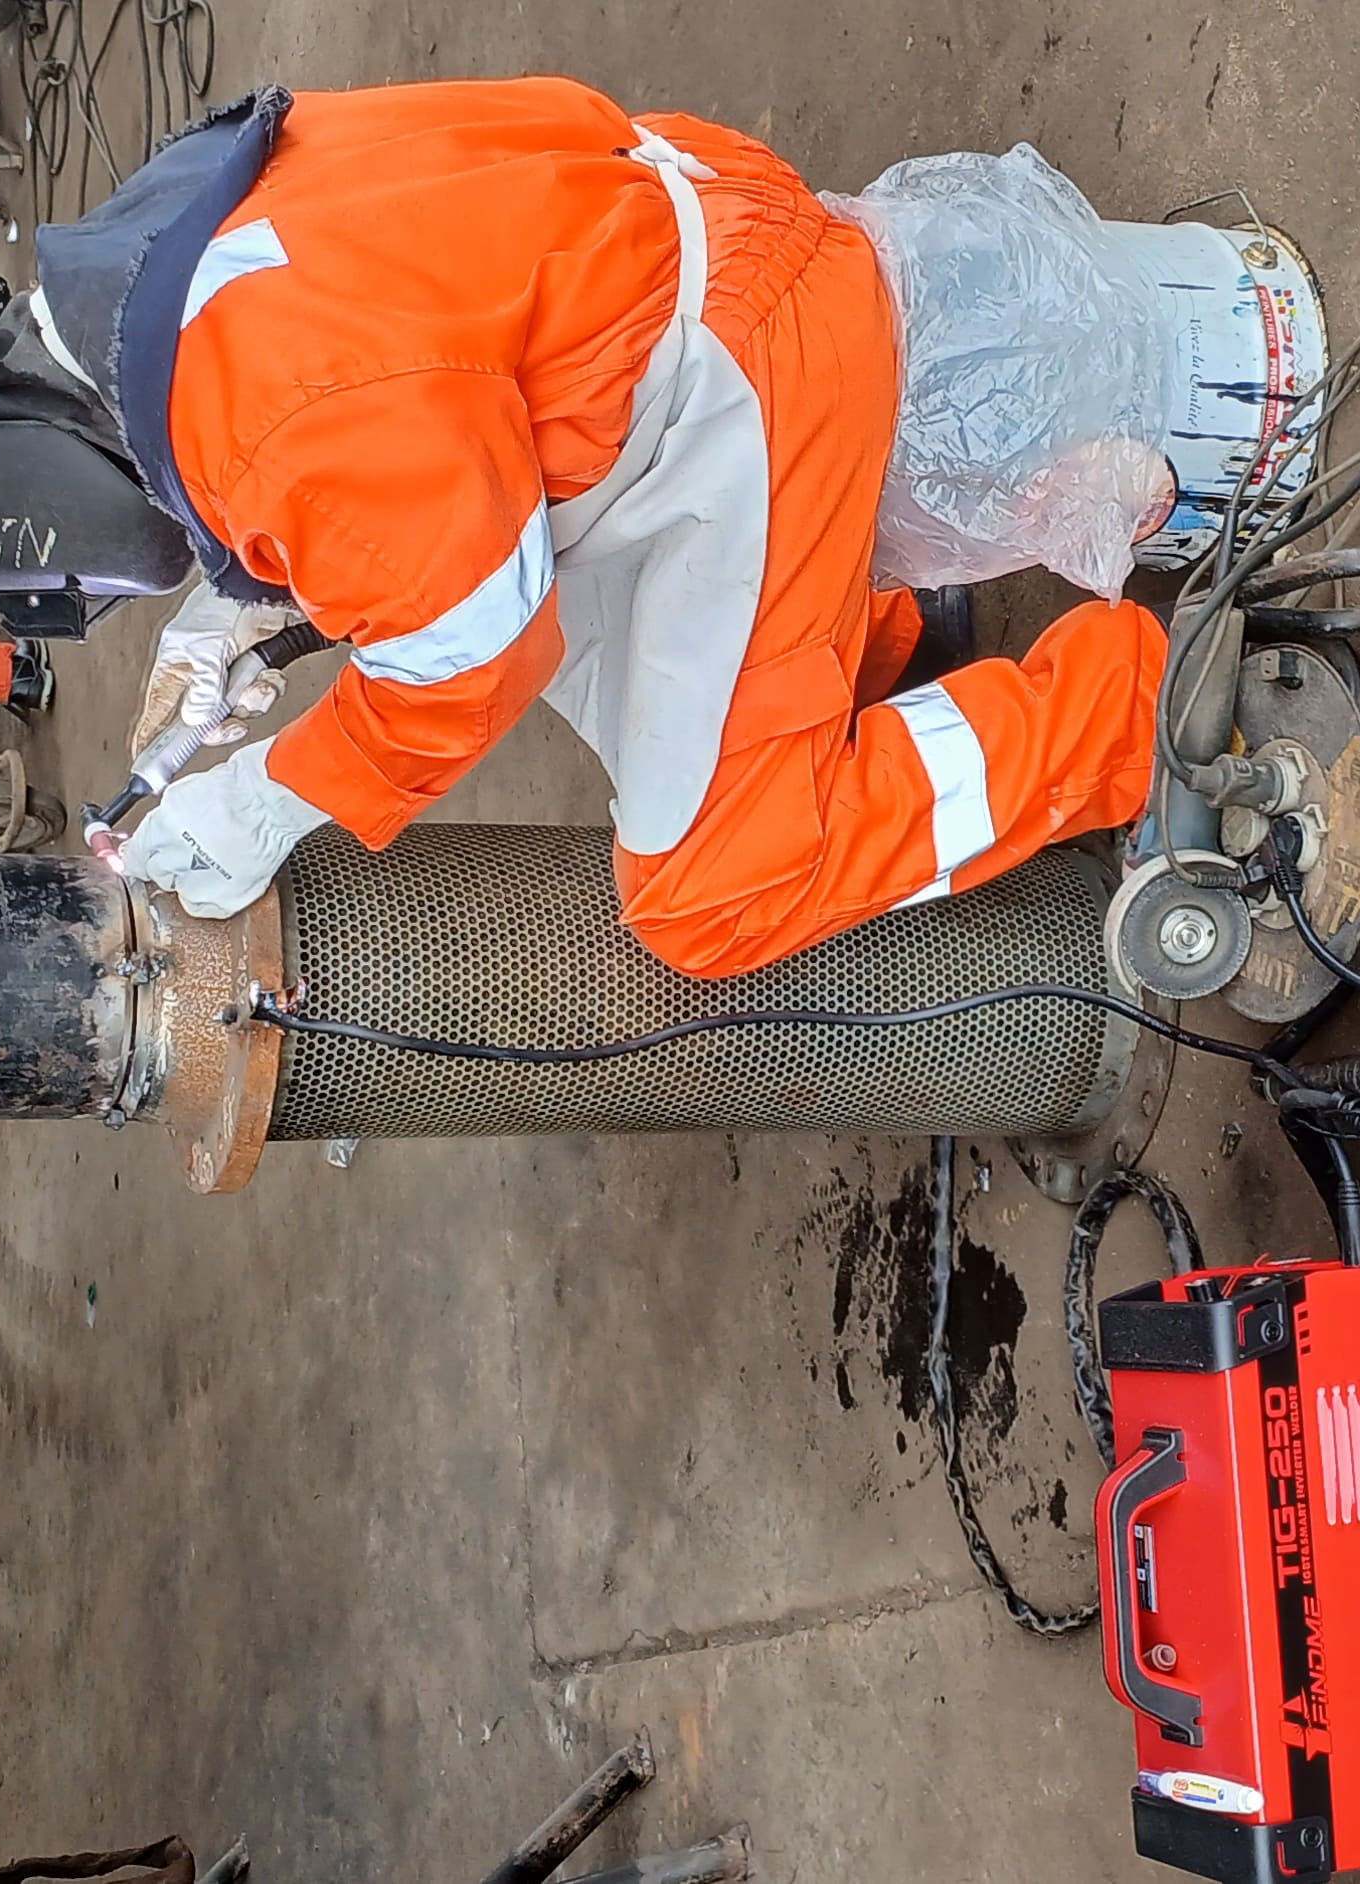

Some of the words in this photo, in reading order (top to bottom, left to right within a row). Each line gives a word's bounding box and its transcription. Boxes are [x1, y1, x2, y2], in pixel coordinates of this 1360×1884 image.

[1258, 288, 1278, 350] PEINTURES
[181, 831, 232, 880] DELTAPLUS
[1288, 1385, 1301, 1435] WELDER
[1264, 1386, 1300, 1589] TIG-250
[1291, 1439, 1306, 1499] INVERTER
[1296, 1502, 1313, 1584] IGBT&SMART
